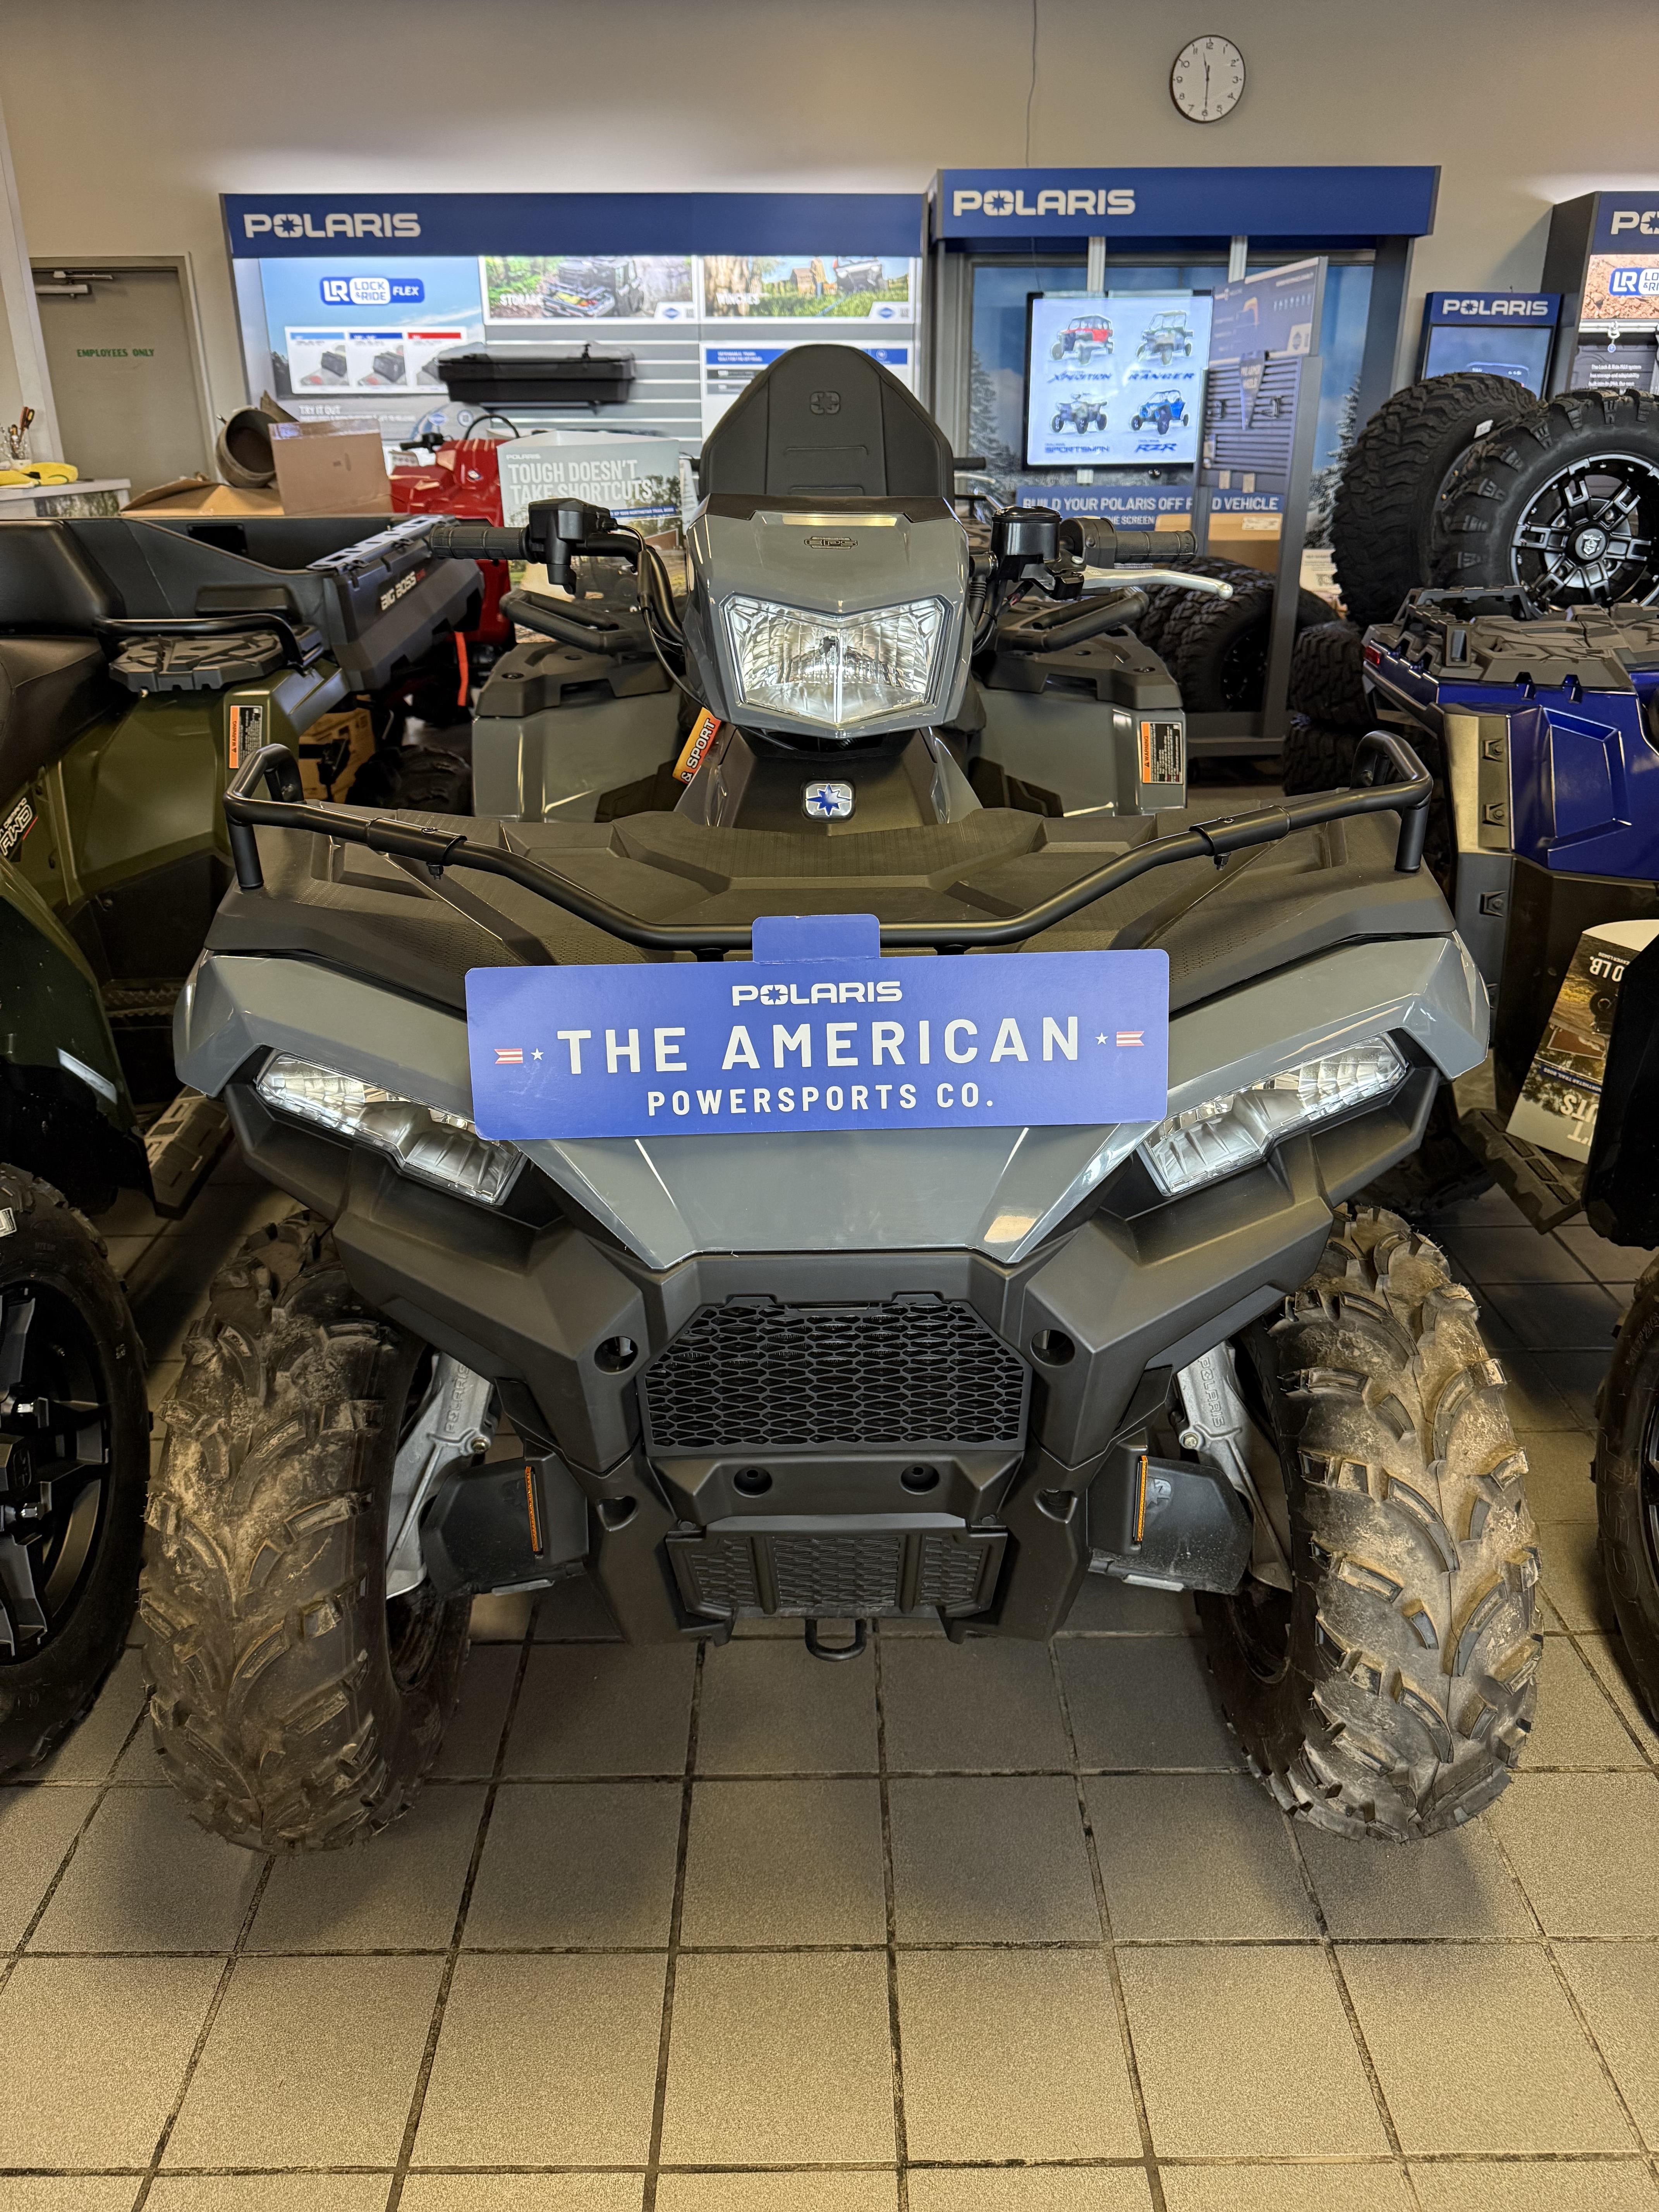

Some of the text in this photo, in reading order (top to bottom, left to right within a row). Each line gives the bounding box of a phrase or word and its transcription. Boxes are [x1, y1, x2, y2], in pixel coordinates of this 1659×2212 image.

[953, 189, 1135, 217] POLARIS
[244, 213, 421, 237] POLARIS
[354, 282, 419, 296] LOCK FLEX
[1443, 299, 1548, 316] POLARIS
[508, 460, 638, 484] TOUGH DOESN'T
[510, 479, 652, 505] TAKE SHORTCUTS
[1064, 498, 1098, 510] YOUR
[1101, 498, 1156, 510] POLARIS
[1158, 497, 1184, 510] OFF
[1224, 497, 1279, 510] VEHICLE
[1121, 516, 1155, 524] SCREEN
[804, 539, 858, 548] EPS
[380, 588, 395, 610] BIG
[395, 570, 416, 599] BOSS
[681, 718, 715, 782] & SPORT
[0, 804, 33, 856] AWD
[1589, 956, 1612, 978] LB.
[732, 981, 903, 1006] POLARIS
[557, 1016, 1078, 1075] THE AMERICAN
[648, 1082, 994, 1116] POWERSPORTS CO.
[444, 1364, 470, 1434] POLARIS
[1198, 1357, 1225, 1427] POLARIS
